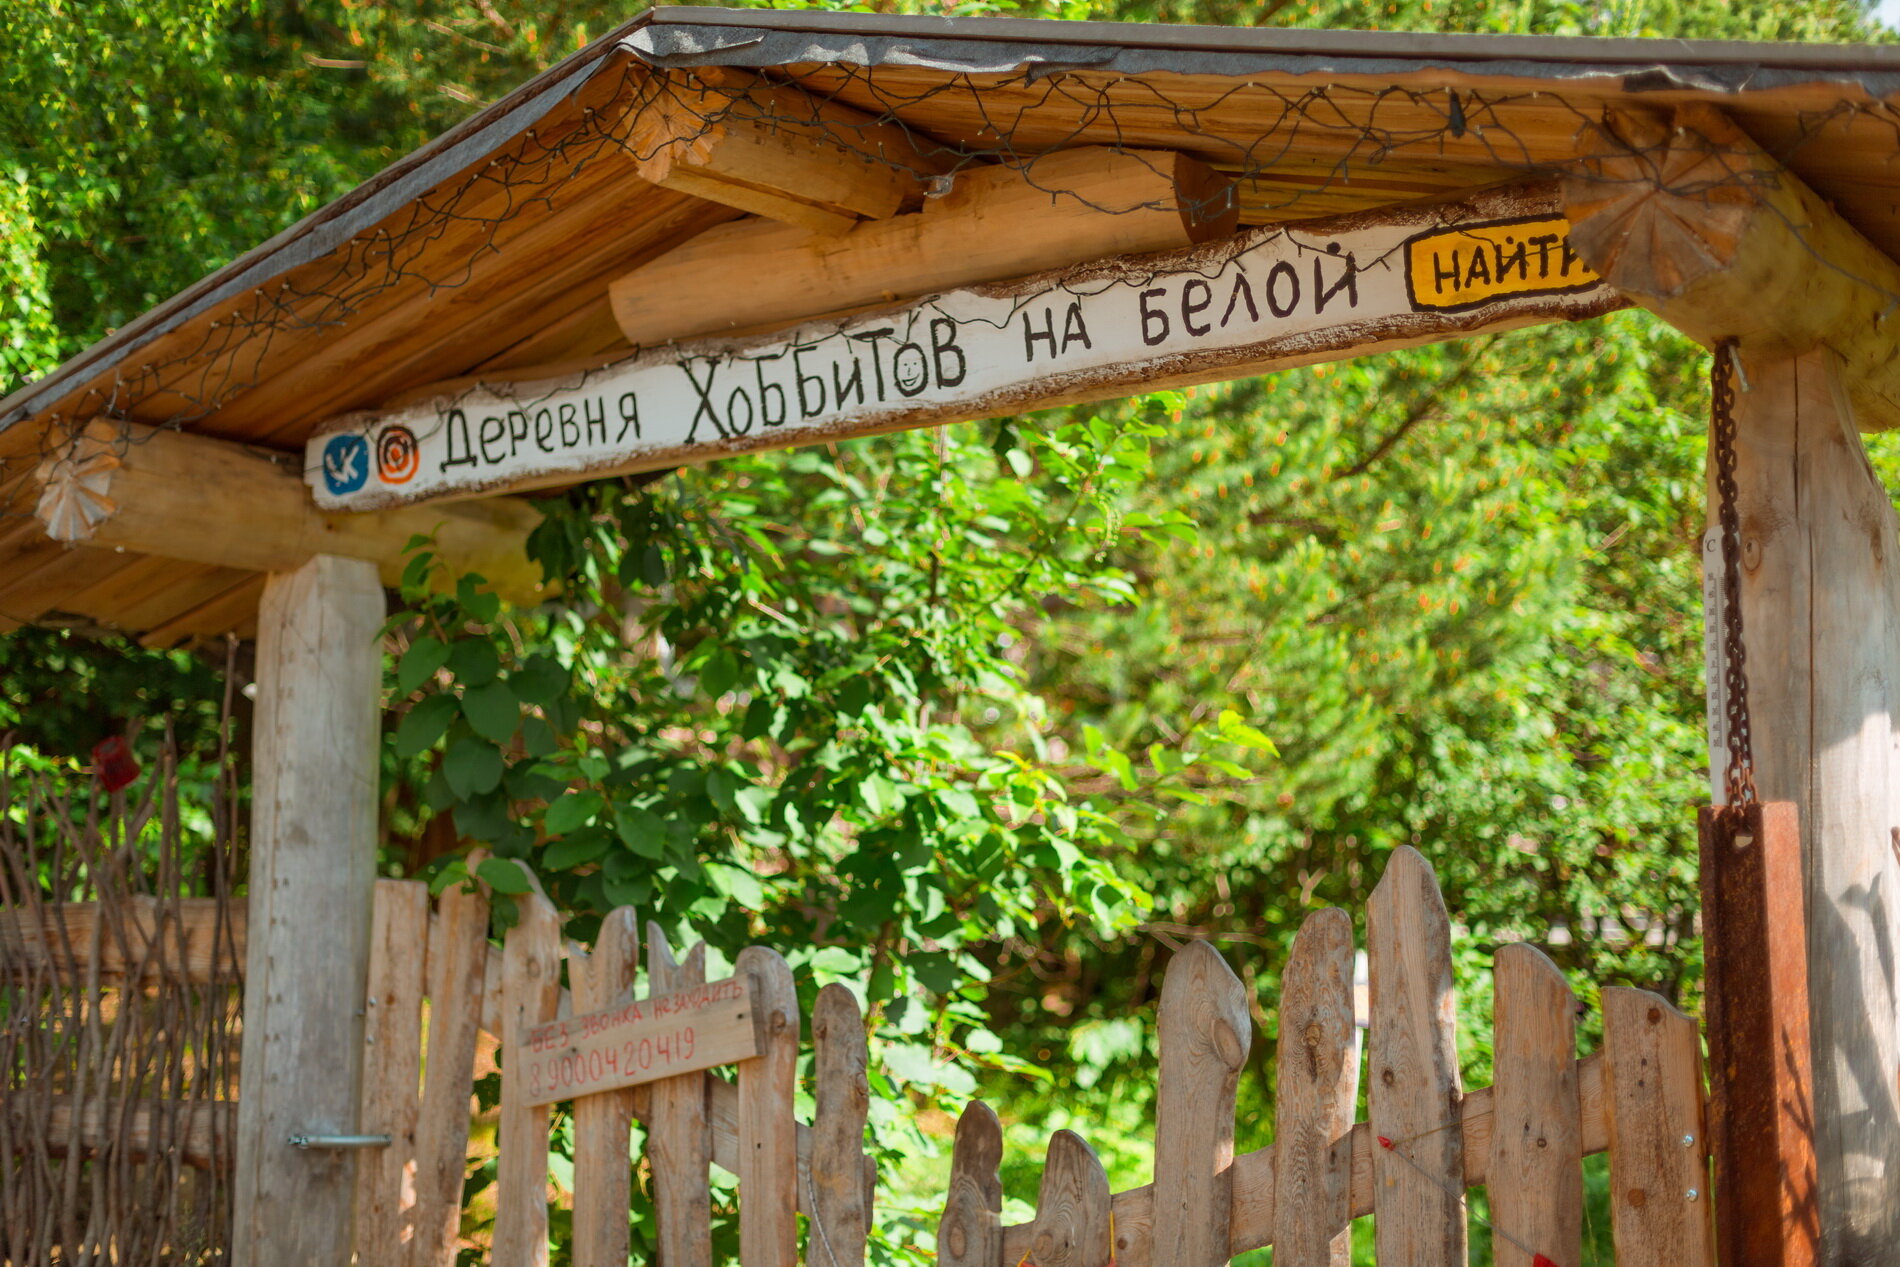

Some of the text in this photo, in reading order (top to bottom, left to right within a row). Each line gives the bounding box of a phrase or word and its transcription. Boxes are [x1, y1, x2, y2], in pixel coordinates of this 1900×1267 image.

[1023, 301, 1092, 362] НА
[530, 1024, 569, 1053] БЕЗ
[581, 1008, 643, 1040] ЗВОНКА
